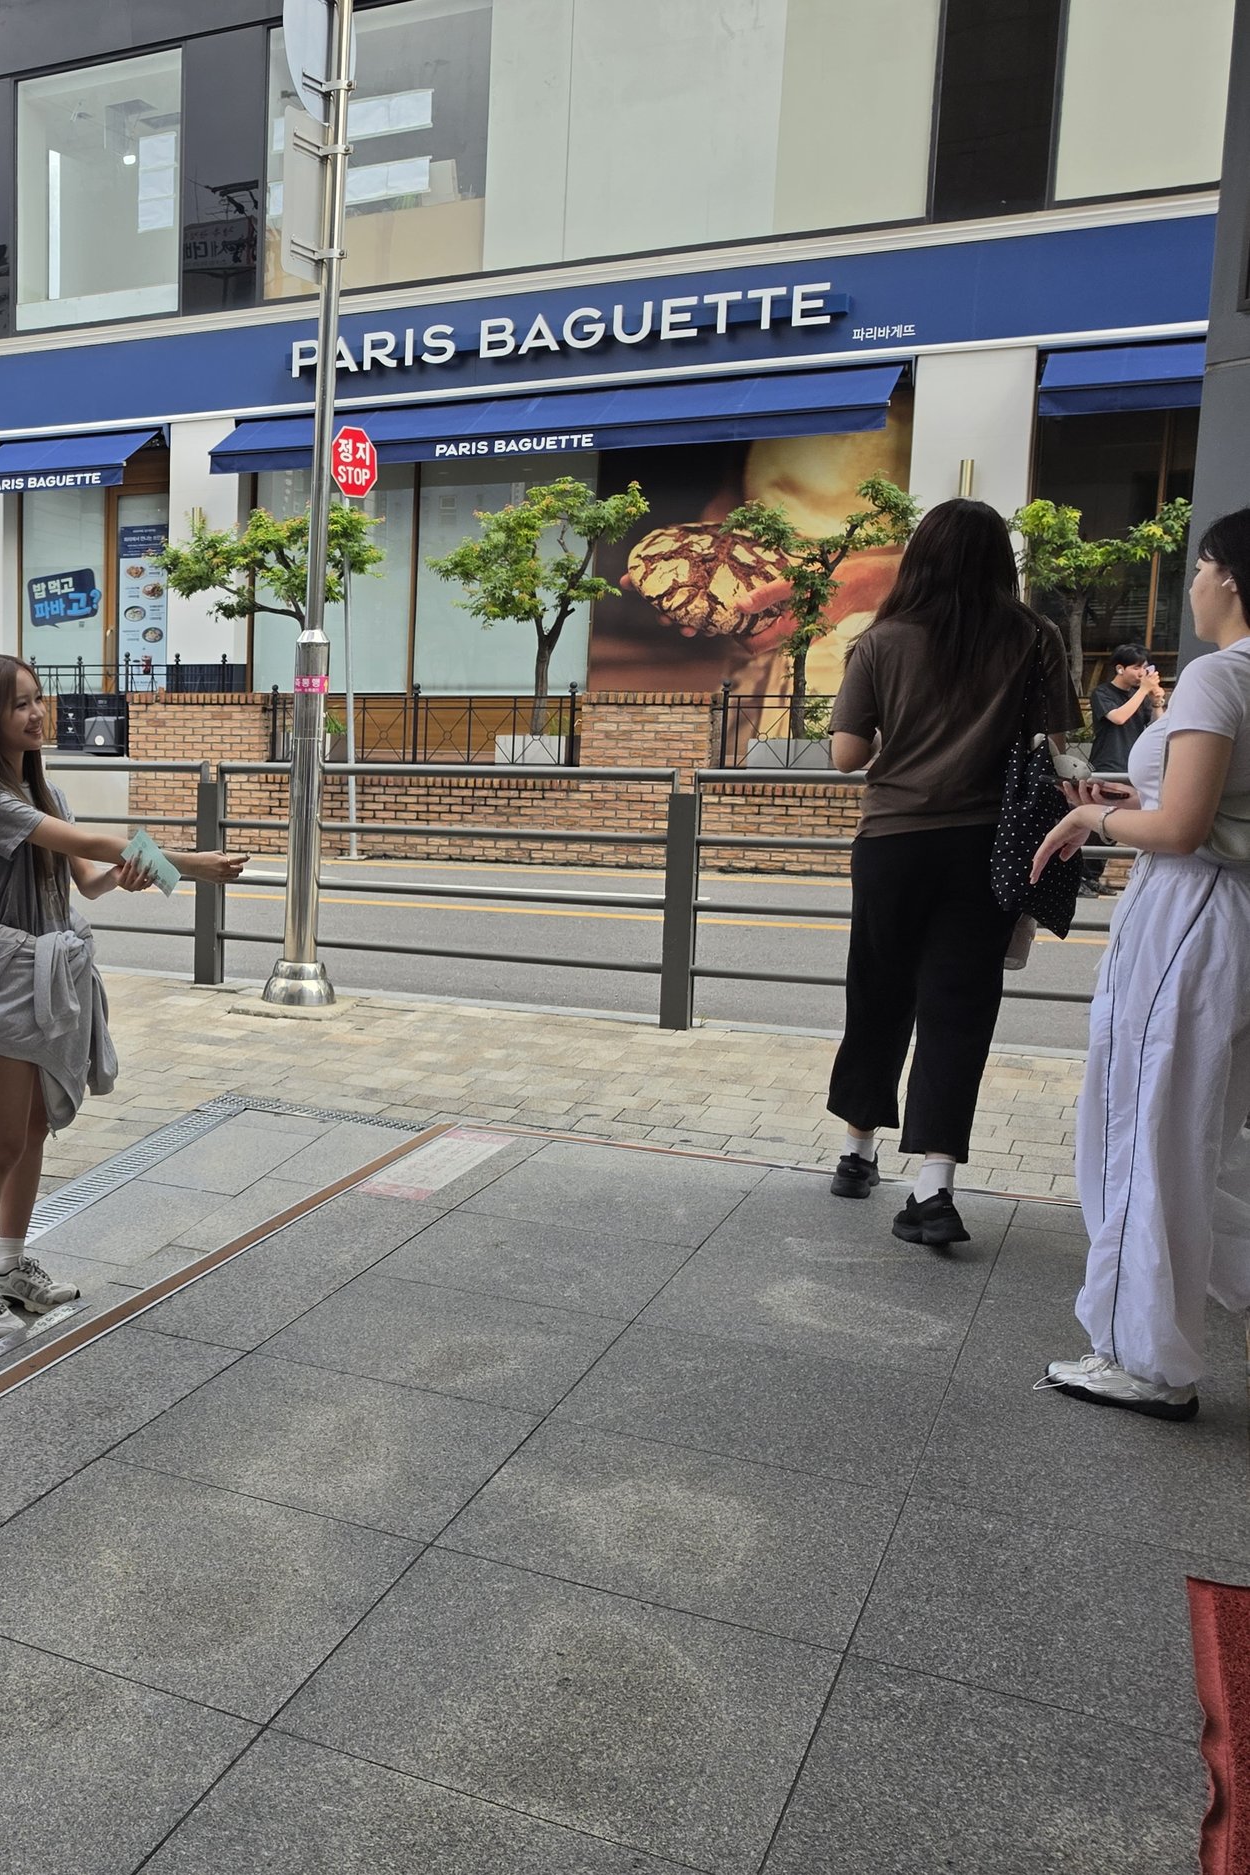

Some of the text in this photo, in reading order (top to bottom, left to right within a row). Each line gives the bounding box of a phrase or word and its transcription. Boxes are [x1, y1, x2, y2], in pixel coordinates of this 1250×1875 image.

[291, 281, 831, 378] PARIS BAGUETTE
[852, 324, 916, 342] 파리바게뜨
[337, 438, 370, 466] 정지
[435, 434, 594, 457] PARIS BAGUETTE
[27, 472, 102, 488] BAGUETTE
[337, 465, 370, 487] STOP
[32, 577, 75, 600] 밥 먹고
